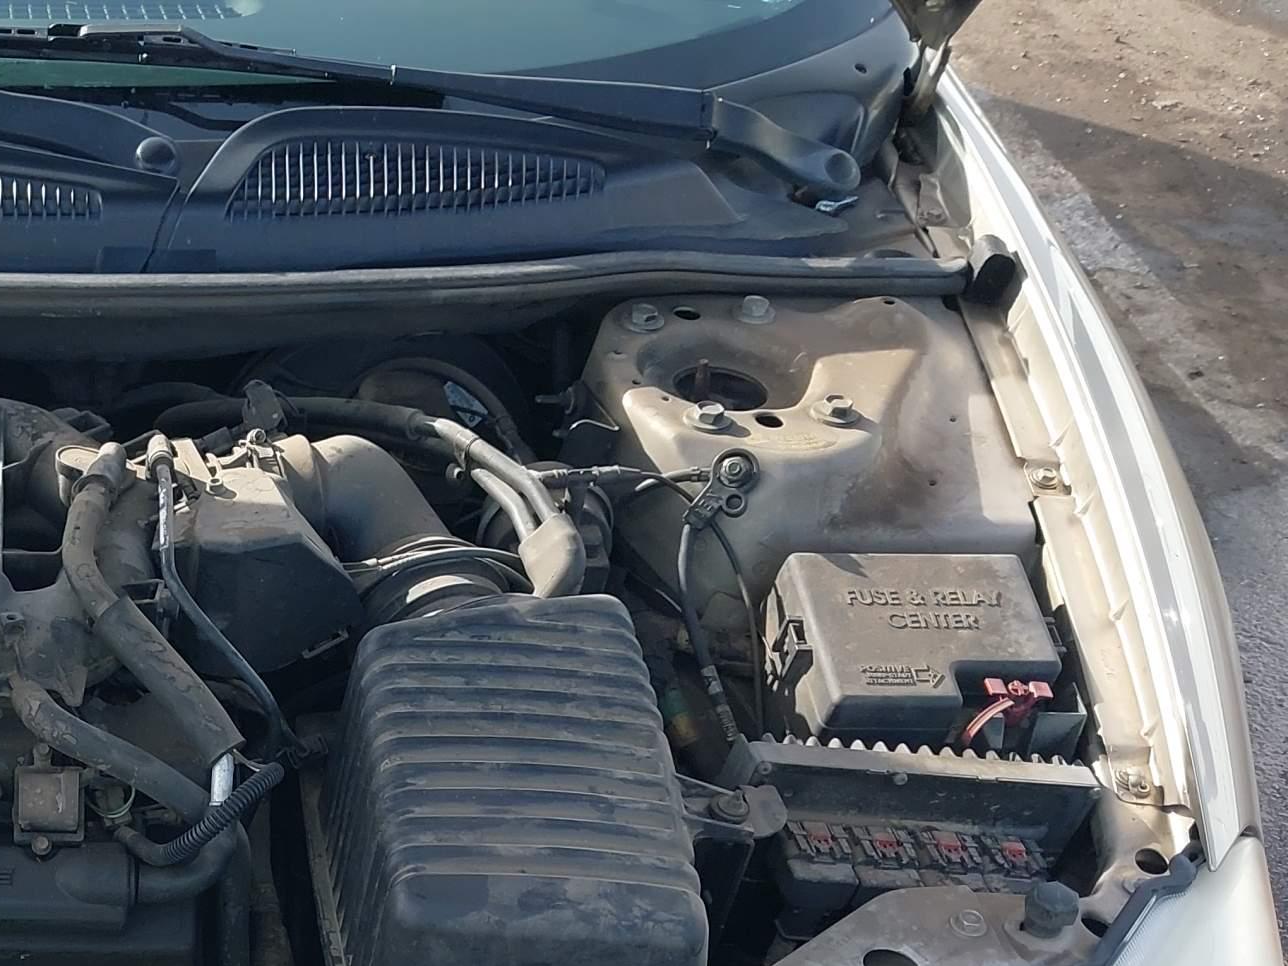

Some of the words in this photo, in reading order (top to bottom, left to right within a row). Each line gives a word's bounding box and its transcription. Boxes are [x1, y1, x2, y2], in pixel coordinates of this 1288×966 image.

[847, 589, 902, 606] FUSE
[910, 590, 926, 606] &
[933, 590, 1002, 607] RELAY
[888, 612, 981, 630] CENTER
